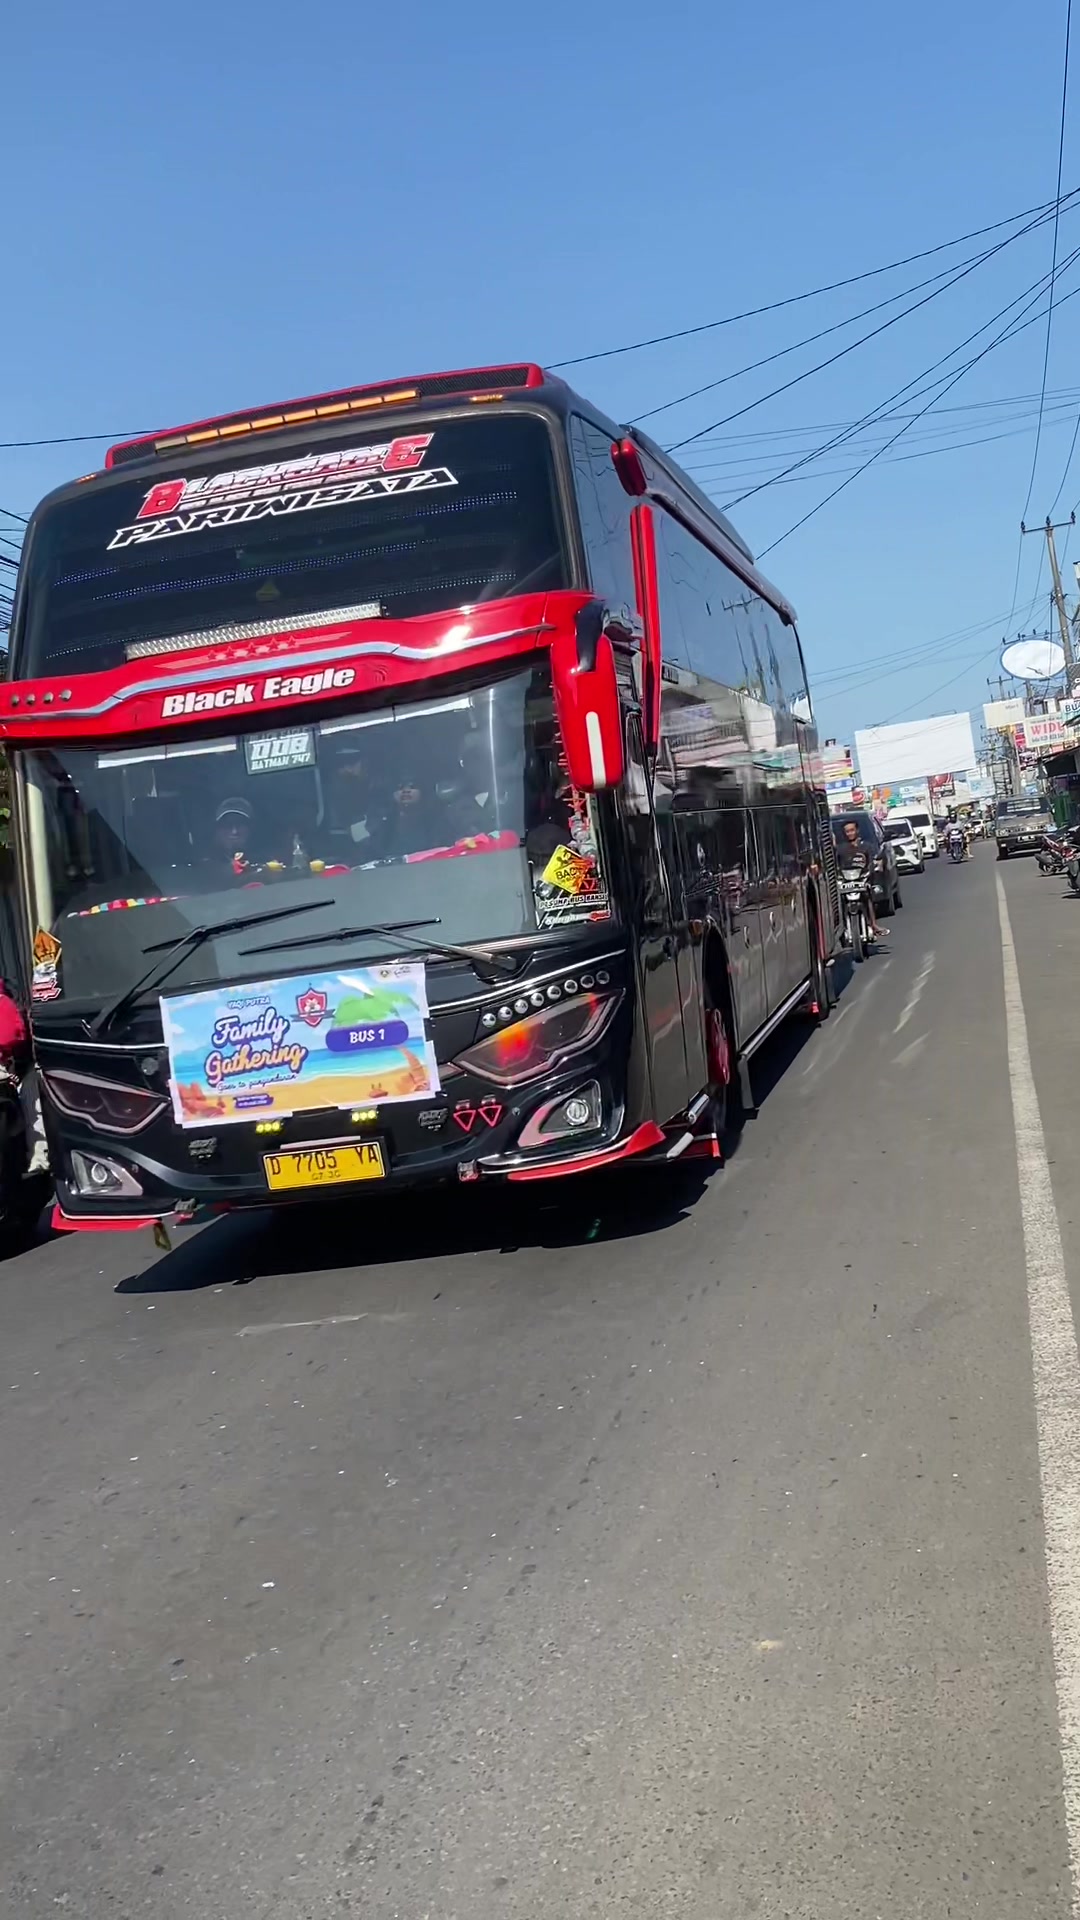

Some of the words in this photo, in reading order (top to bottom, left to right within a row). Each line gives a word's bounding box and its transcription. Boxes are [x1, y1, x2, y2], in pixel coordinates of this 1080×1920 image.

[106, 467, 460, 550] PARIWISATA
[161, 682, 254, 718] Black
[262, 668, 356, 701] Eagle
[251, 755, 290, 770] BATMAN
[291, 752, 311, 764] 747
[245, 996, 271, 1007] PUTRA
[212, 1007, 290, 1046] Family
[349, 1029, 375, 1043] BUS
[377, 1028, 385, 1040] 1
[205, 1043, 307, 1085] Gathering
[270, 1157, 281, 1175] D
[292, 1150, 337, 1173] 7705
[354, 1144, 379, 1165] YA
